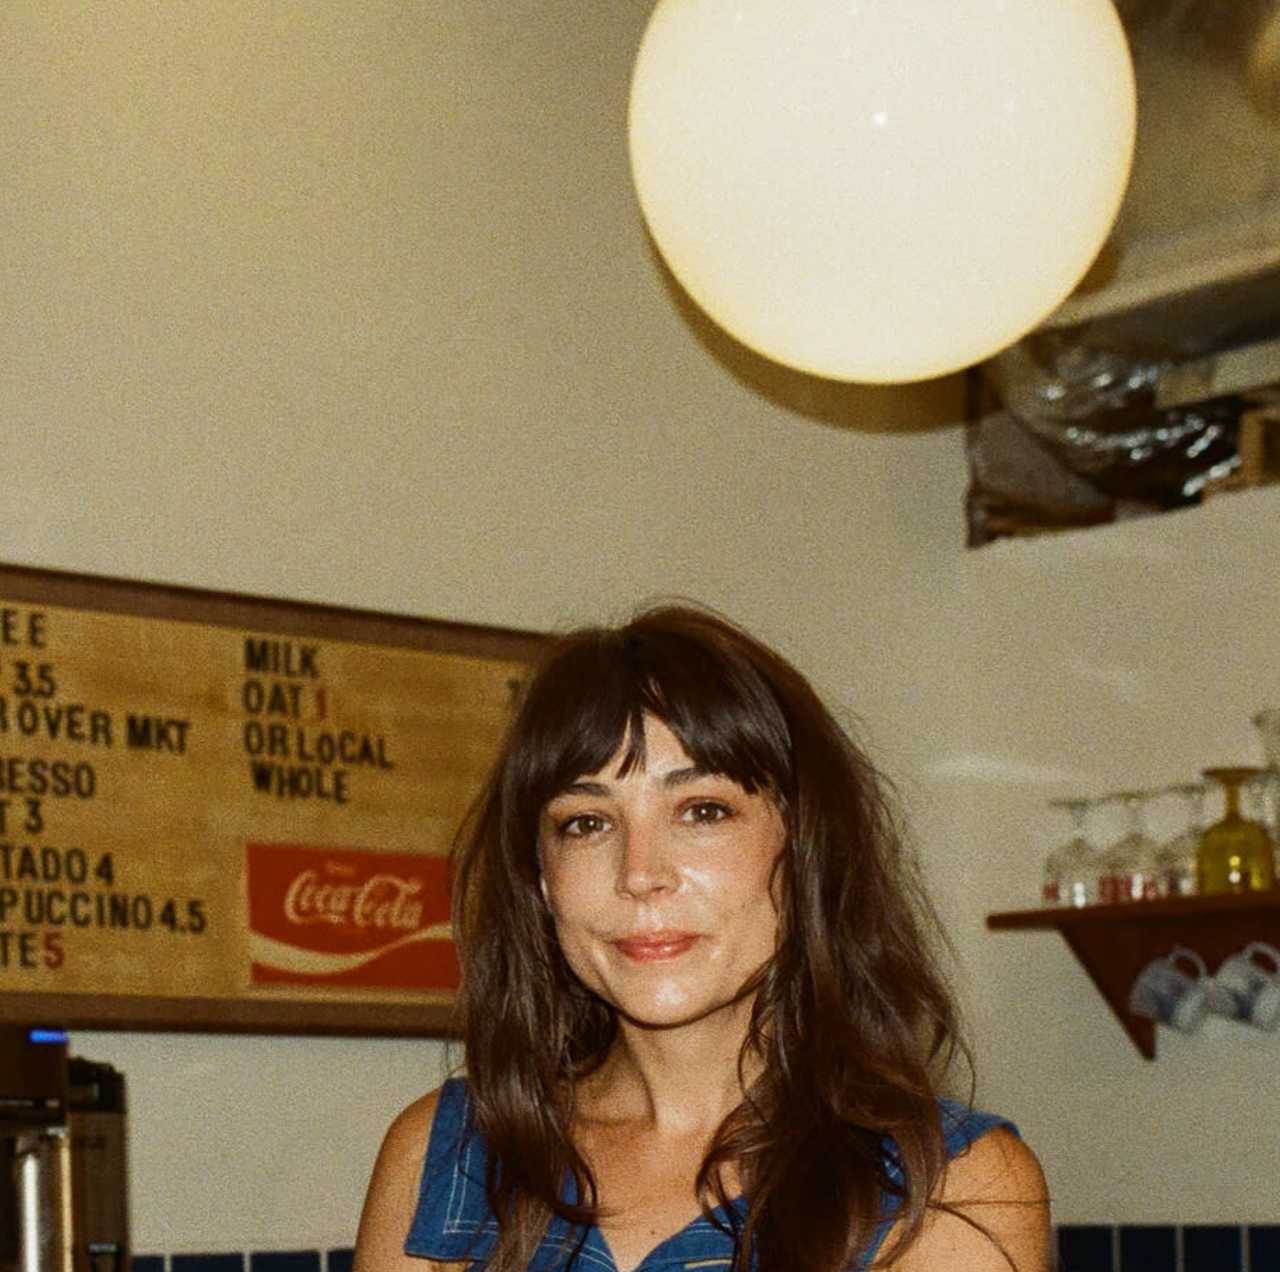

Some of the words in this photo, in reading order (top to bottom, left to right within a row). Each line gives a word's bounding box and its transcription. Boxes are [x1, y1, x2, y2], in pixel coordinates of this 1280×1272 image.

[244, 638, 319, 680] MILK
[242, 680, 303, 720] OAT
[16, 703, 114, 749] OVER
[125, 712, 192, 756] MKT
[243, 721, 289, 758] OR
[296, 730, 395, 772] LOCAL
[250, 762, 351, 805] WHOLE
[24, 799, 45, 834] 3
[95, 852, 115, 888] 4
[160, 898, 208, 936] 4.5
[43, 931, 66, 970] 5
